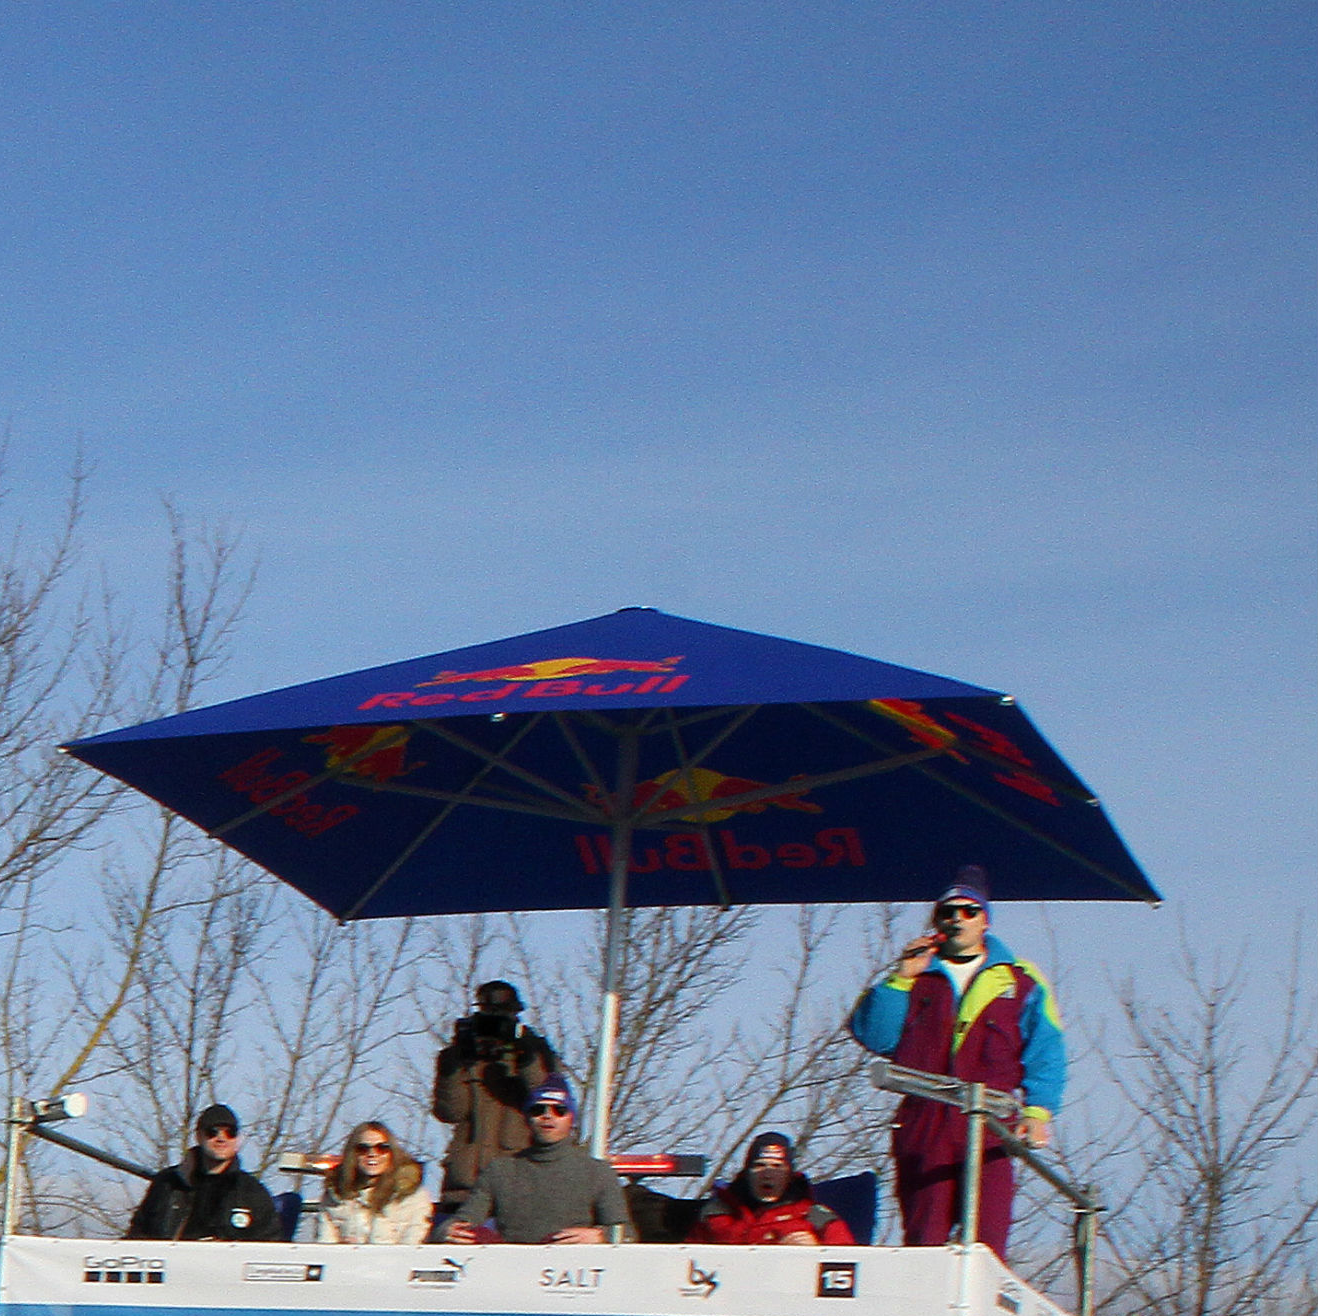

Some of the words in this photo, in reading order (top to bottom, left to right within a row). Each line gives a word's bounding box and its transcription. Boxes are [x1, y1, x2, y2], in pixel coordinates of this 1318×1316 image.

[357, 682, 521, 711] Red
[521, 674, 691, 698] Bull
[84, 1255, 165, 1270] GoPro
[538, 1268, 606, 1288] SALT
[821, 1269, 853, 1290] 15
